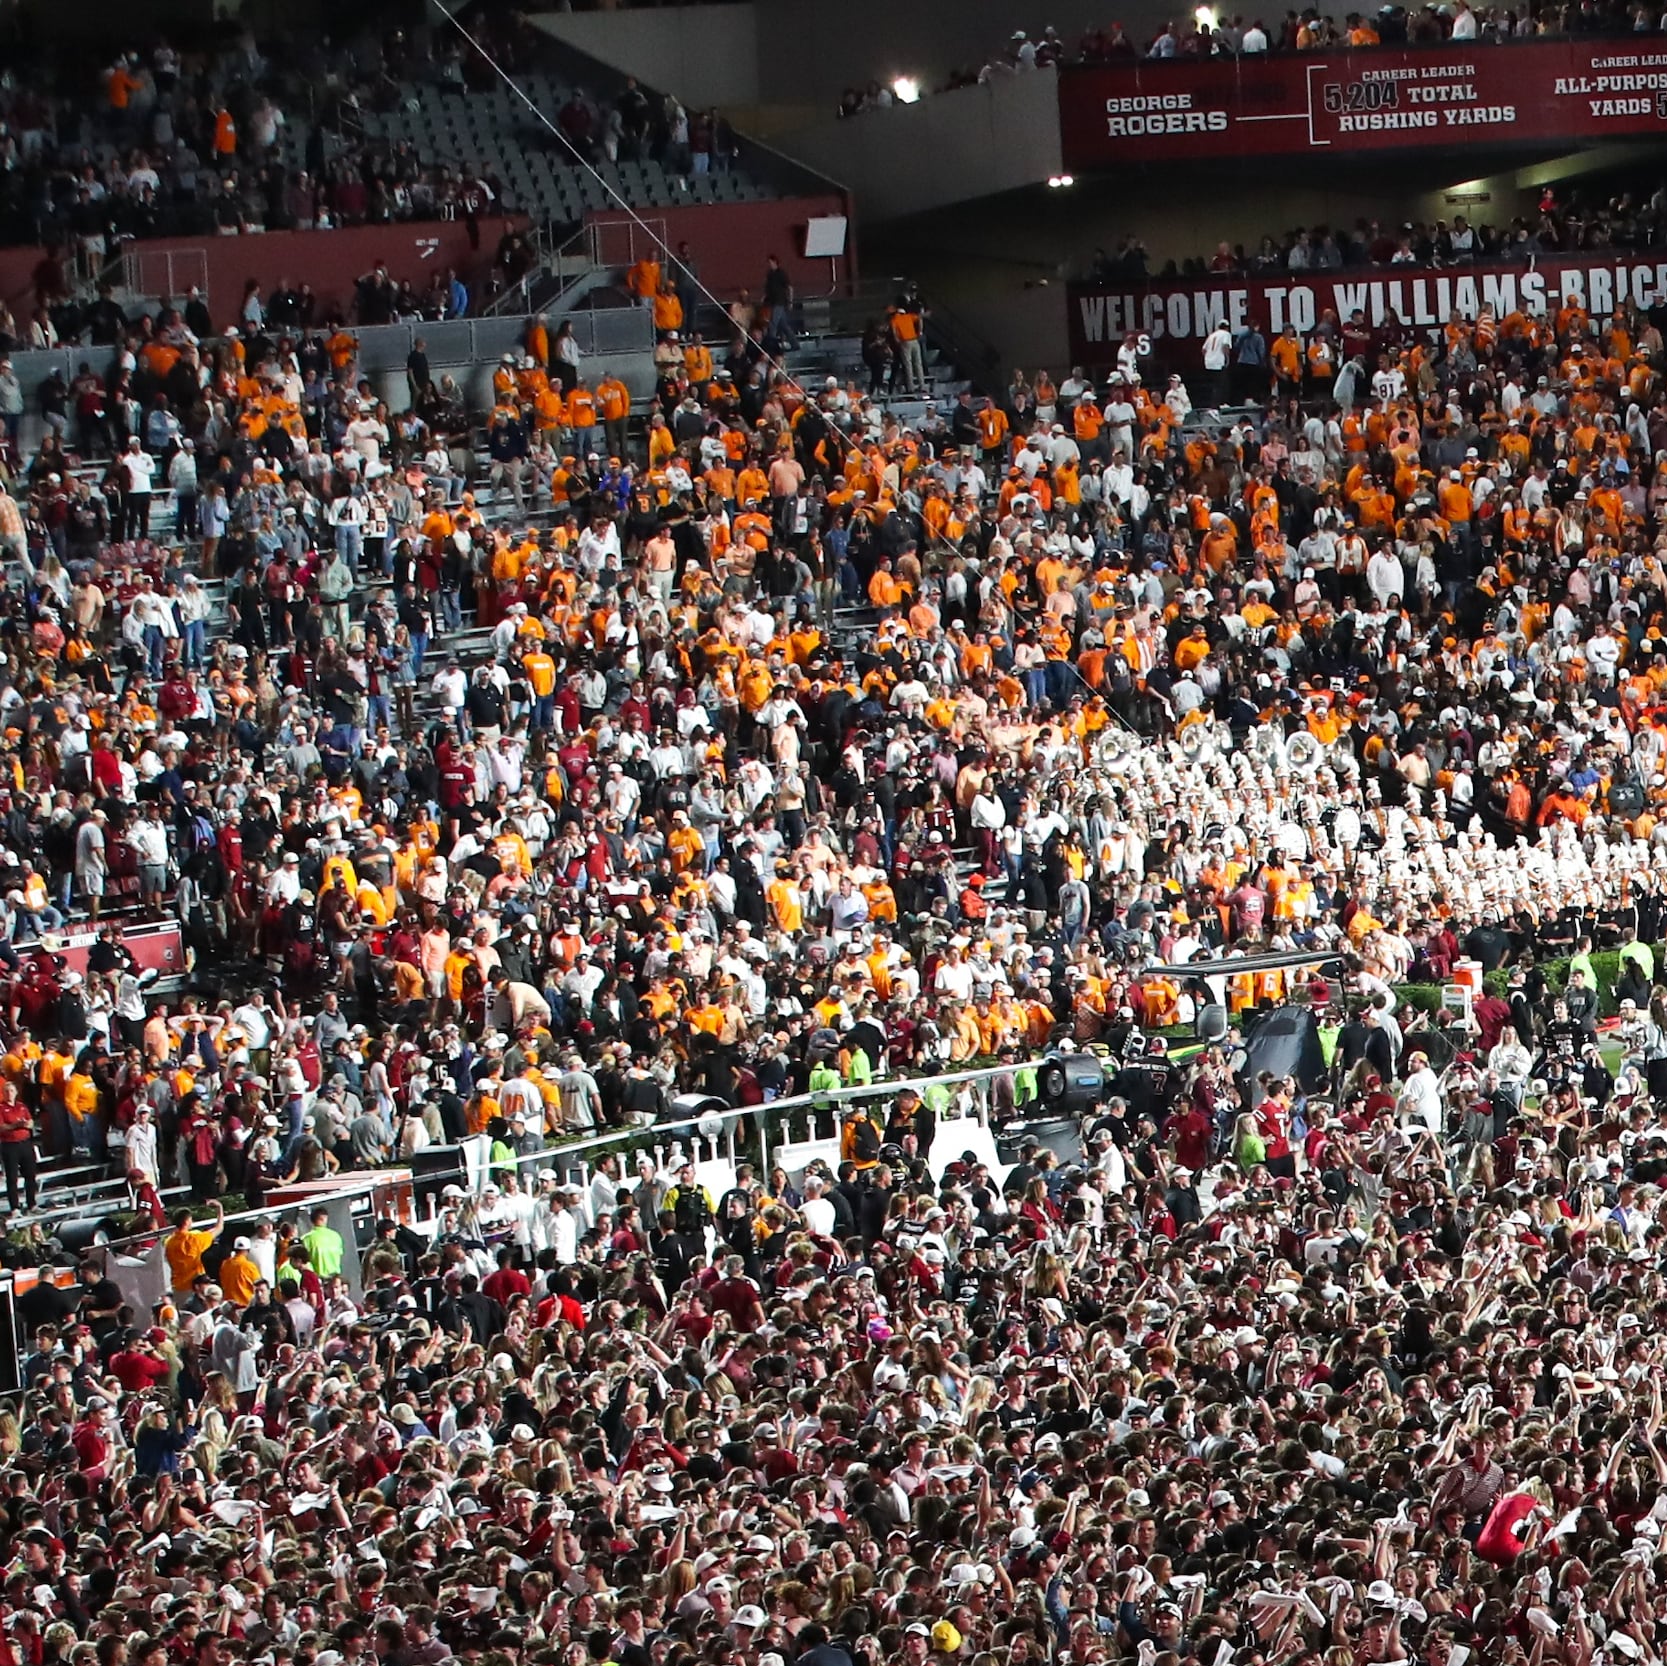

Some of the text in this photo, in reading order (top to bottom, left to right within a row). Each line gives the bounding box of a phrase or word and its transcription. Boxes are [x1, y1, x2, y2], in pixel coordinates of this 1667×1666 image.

[1362, 65, 1475, 82] CAREER LEADER
[1591, 56, 1638, 69] CAREER
[1106, 94, 1192, 114] GEORGE
[1324, 81, 1477, 114] 5,204 TOTAL
[1589, 98, 1651, 118] YARDS
[1107, 111, 1228, 137] ROGERS
[1339, 105, 1516, 132] RUSHING YARDS
[1080, 289, 1249, 343] WELCOME
[1264, 286, 1316, 334] TO
[1379, 384, 1395, 398] 81
[424, 1287, 434, 1313] 1
